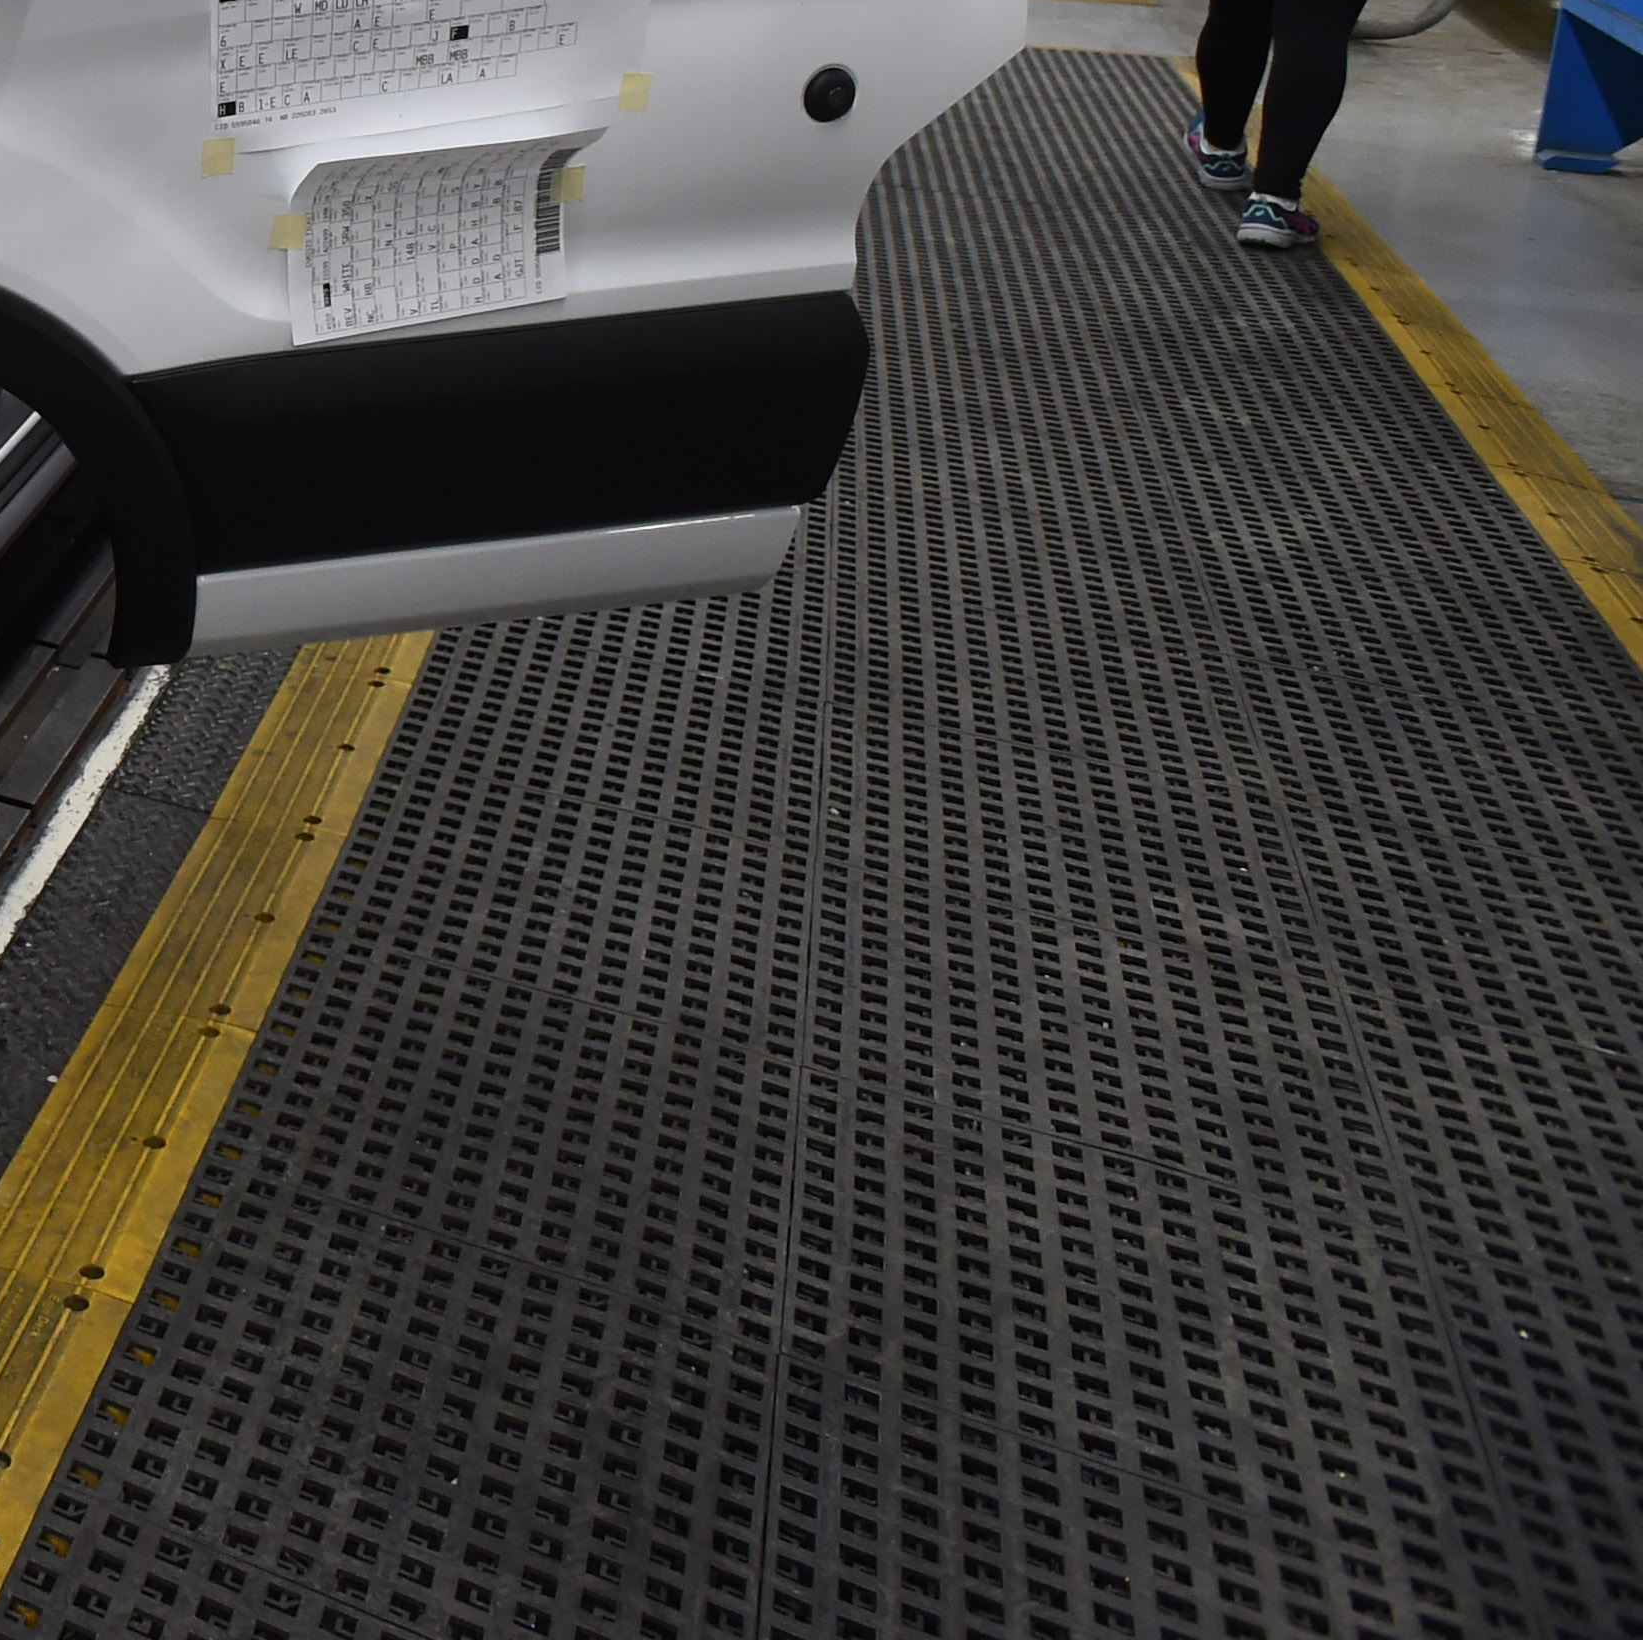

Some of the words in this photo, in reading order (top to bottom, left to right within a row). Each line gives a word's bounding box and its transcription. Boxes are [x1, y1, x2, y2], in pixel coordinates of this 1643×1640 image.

[294, 3, 302, 14] W
[220, 36, 227, 47] 6
[354, 18, 361, 30] A
[374, 16, 381, 27] E
[429, 9, 435, 20] E
[219, 59, 227, 70] X
[239, 56, 246, 67] E
[258, 53, 265, 65] E
[285, 48, 298, 60] LE
[352, 41, 359, 52] C
[372, 38, 379, 50] E
[432, 31, 439, 42] J
[452, 28, 459, 39] F
[219, 81, 226, 93] E
[558, 34, 565, 45] E
[218, 103, 227, 116] H
[284, 94, 291, 106] C
[304, 91, 311, 103] A
[381, 81, 388, 92] C
[440, 72, 453, 85] LA
[479, 68, 486, 78] A
[341, 200, 351, 218] 350
[427, 224, 436, 232] C
[470, 219, 478, 227] H
[341, 225, 350, 245] SRW
[385, 239, 393, 247] N
[514, 259, 524, 277] GJT
[341, 263, 351, 293] WHITE
[431, 301, 440, 311] TL
[475, 296, 482, 304] H
[344, 307, 353, 327] BEV
[366, 309, 375, 323] NC
